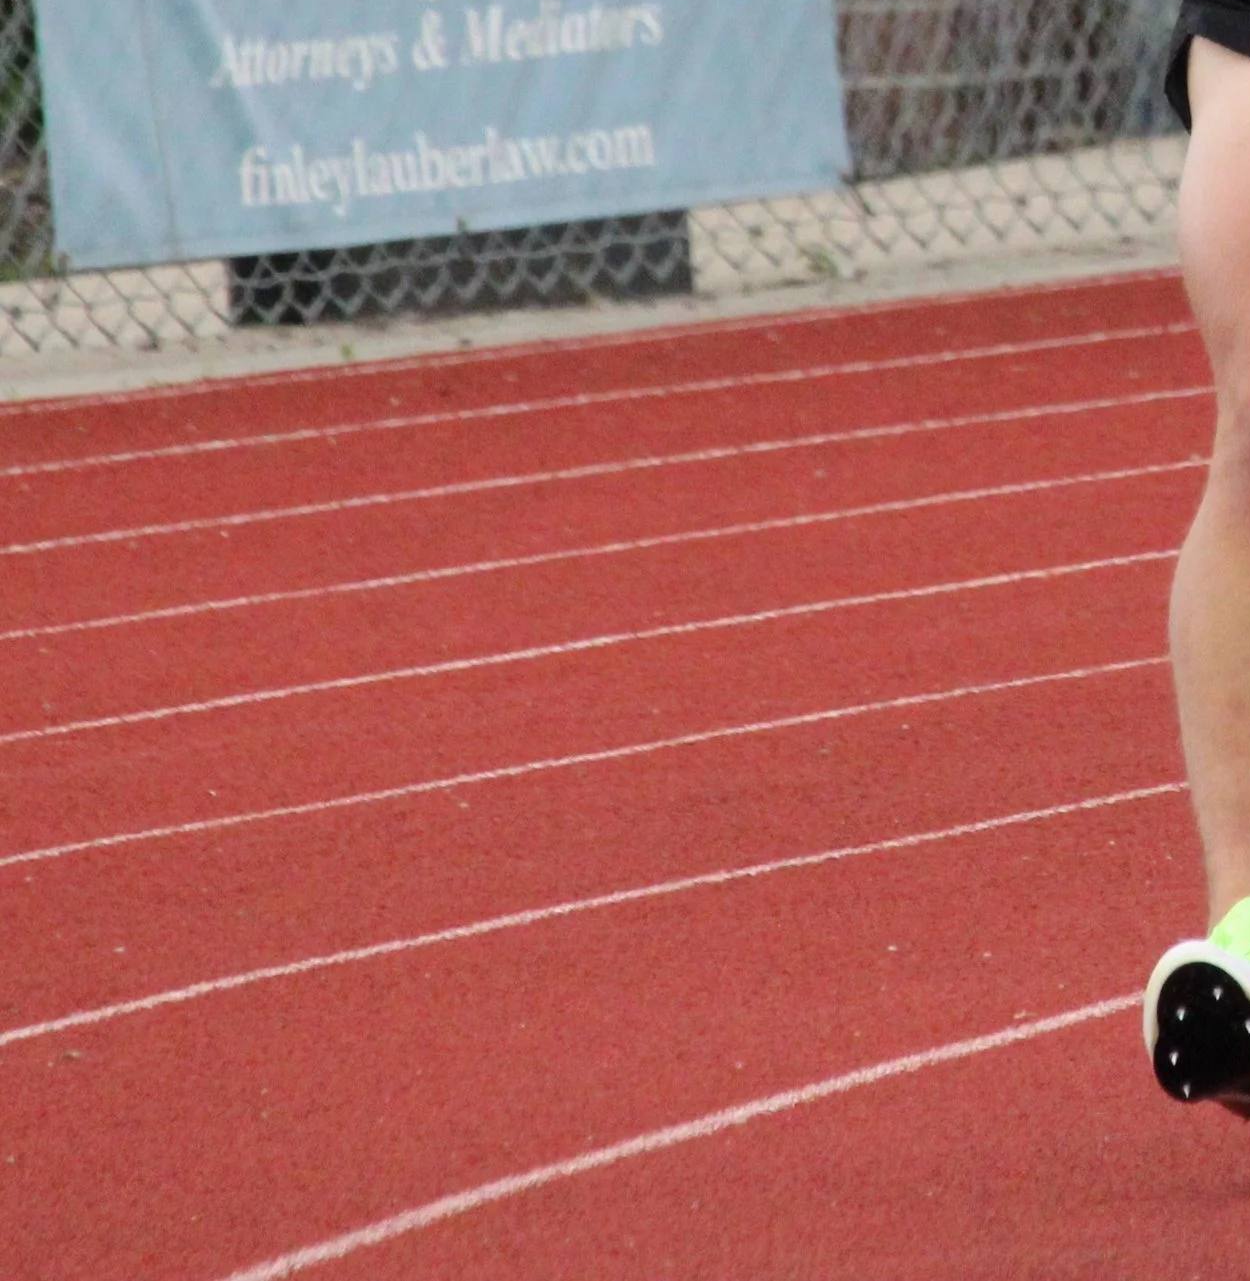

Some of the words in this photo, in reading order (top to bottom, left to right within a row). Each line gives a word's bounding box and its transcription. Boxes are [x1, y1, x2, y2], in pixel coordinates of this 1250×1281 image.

[210, 31, 399, 91] Attorneys
[412, 8, 449, 70] &
[460, 0, 664, 65] Mediators
[241, 123, 655, 215] finleylauberlaw.com
